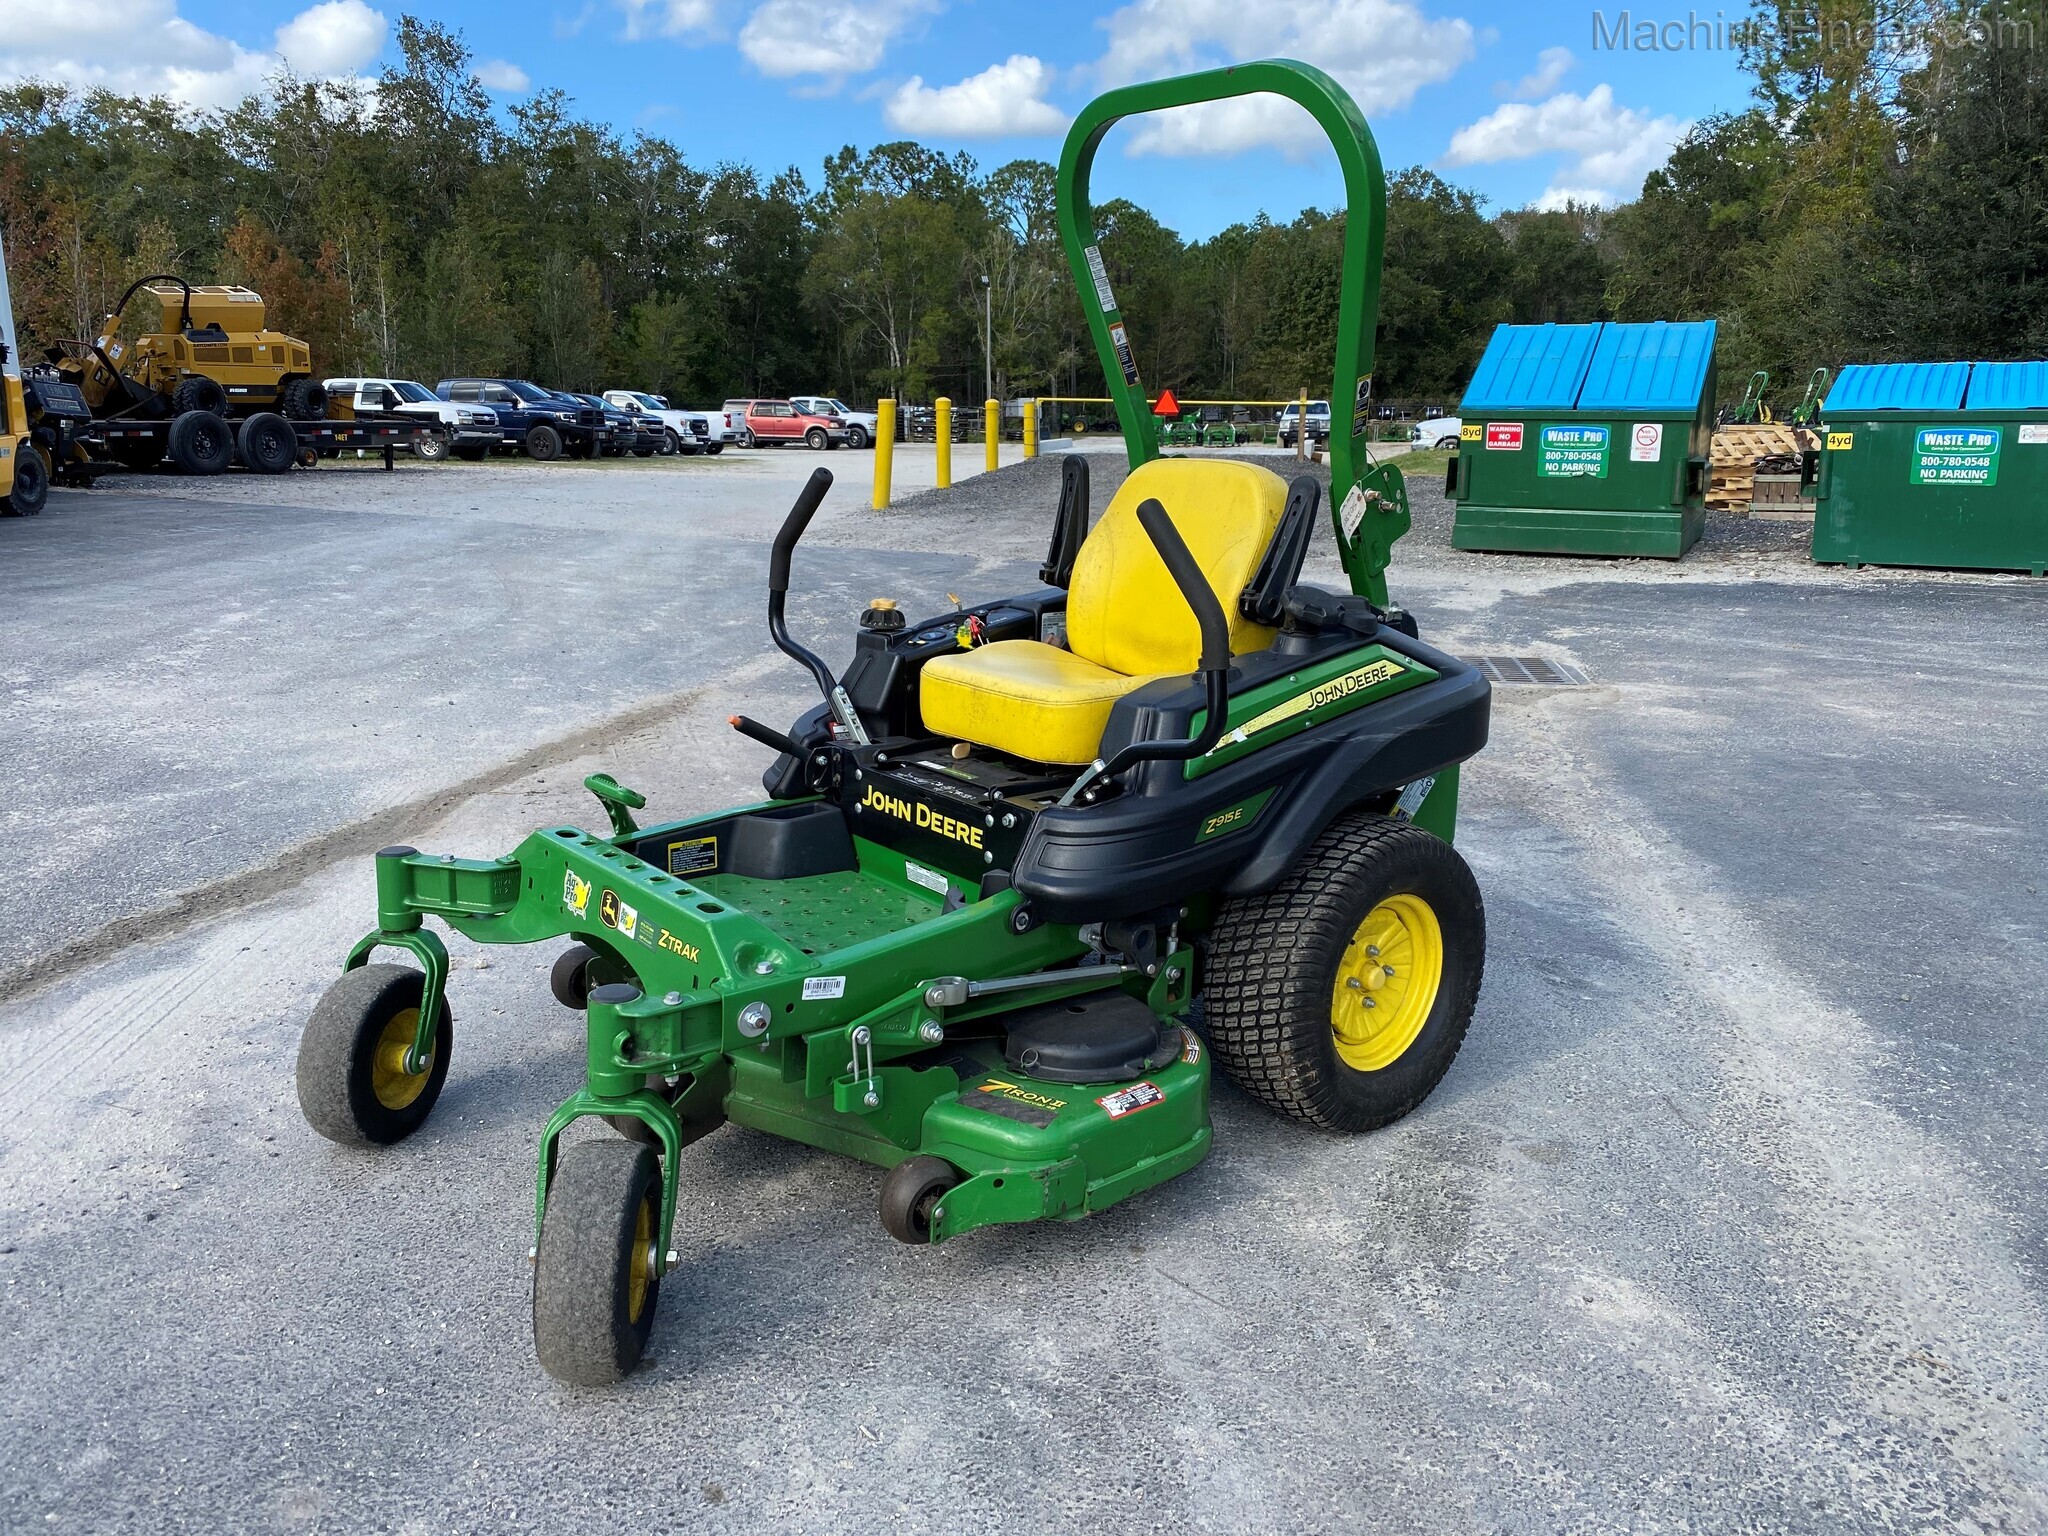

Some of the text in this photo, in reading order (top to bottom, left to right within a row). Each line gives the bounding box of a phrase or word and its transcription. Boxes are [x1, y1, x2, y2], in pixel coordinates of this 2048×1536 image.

[1462, 428, 1481, 438] 8yd
[1547, 430, 1603, 442] WASTE PRO
[1829, 435, 1852, 447] 4yd
[1924, 433, 1992, 446] WASTE PRO
[1545, 451, 1602, 461] 800-780-0548
[1920, 456, 1990, 467] 800-780-0548
[1545, 462, 1601, 472] NO PARKING
[1920, 469, 1988, 479] NO PARKING
[1308, 665, 1389, 709] JOHN DEERE
[861, 784, 912, 823] JOHN
[916, 802, 984, 850] DEERE
[1205, 808, 1243, 834] Z915E
[658, 928, 700, 963] ZTRAK
